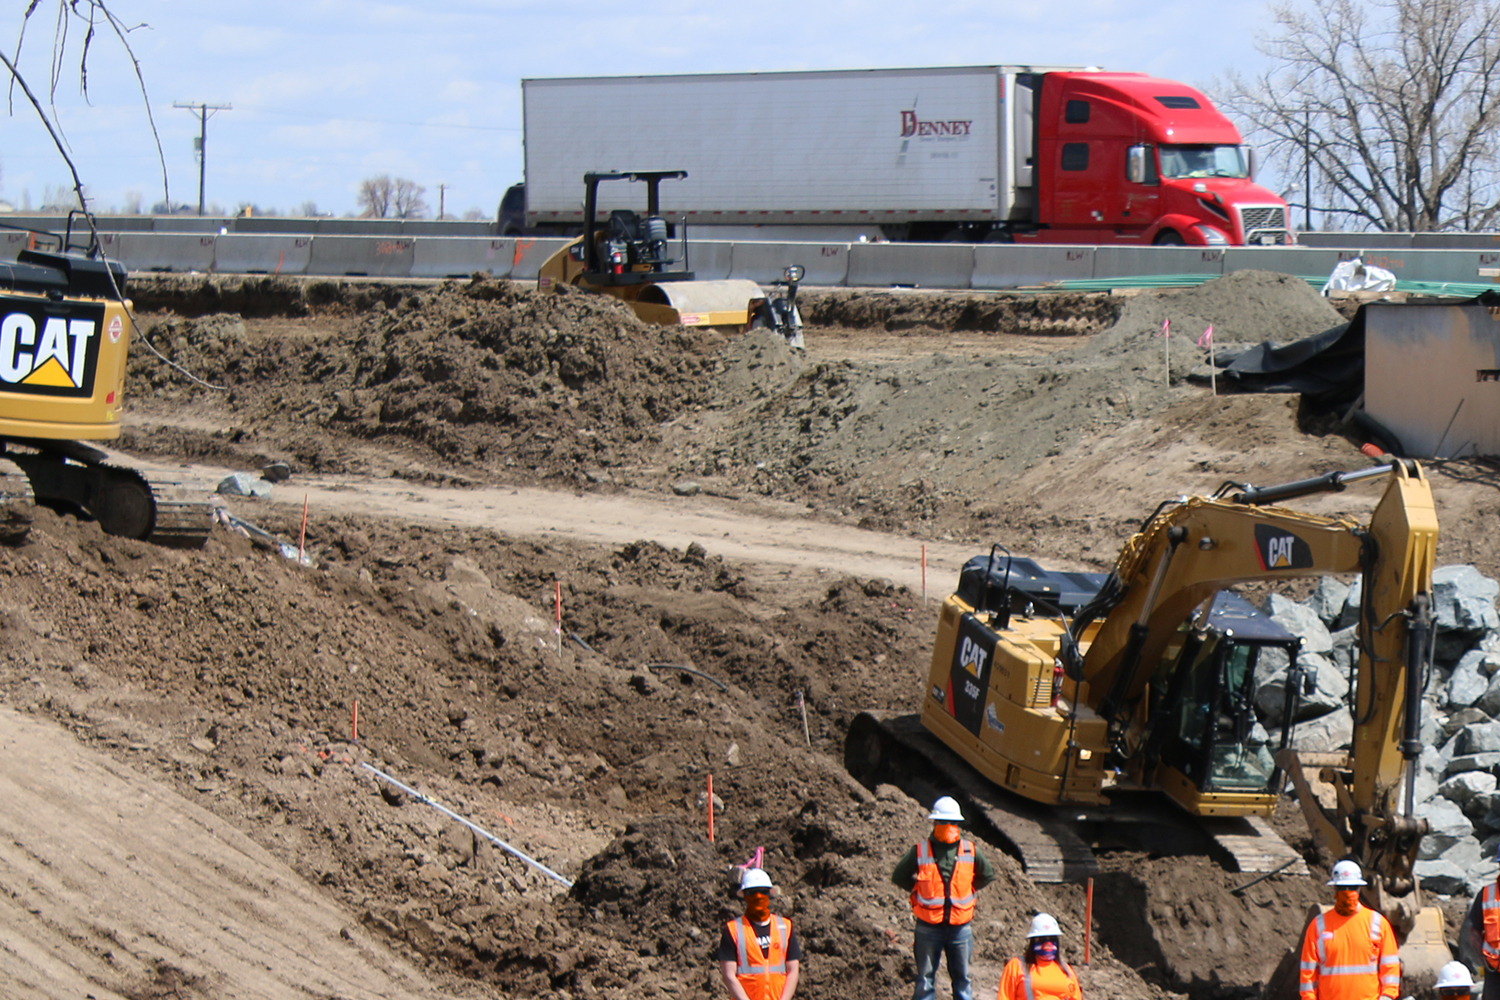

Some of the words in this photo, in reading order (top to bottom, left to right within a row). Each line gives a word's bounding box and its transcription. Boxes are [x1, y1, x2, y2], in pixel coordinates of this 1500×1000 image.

[900, 110, 973, 138] DENNEY
[821, 246, 839, 257] RLW
[1066, 250, 1084, 262] RLW
[1201, 251, 1221, 262] RLW
[1479, 253, 1500, 265] RLW
[0, 311, 96, 388] CAT
[1269, 536, 1295, 567] CAT
[960, 635, 988, 680] CAT
